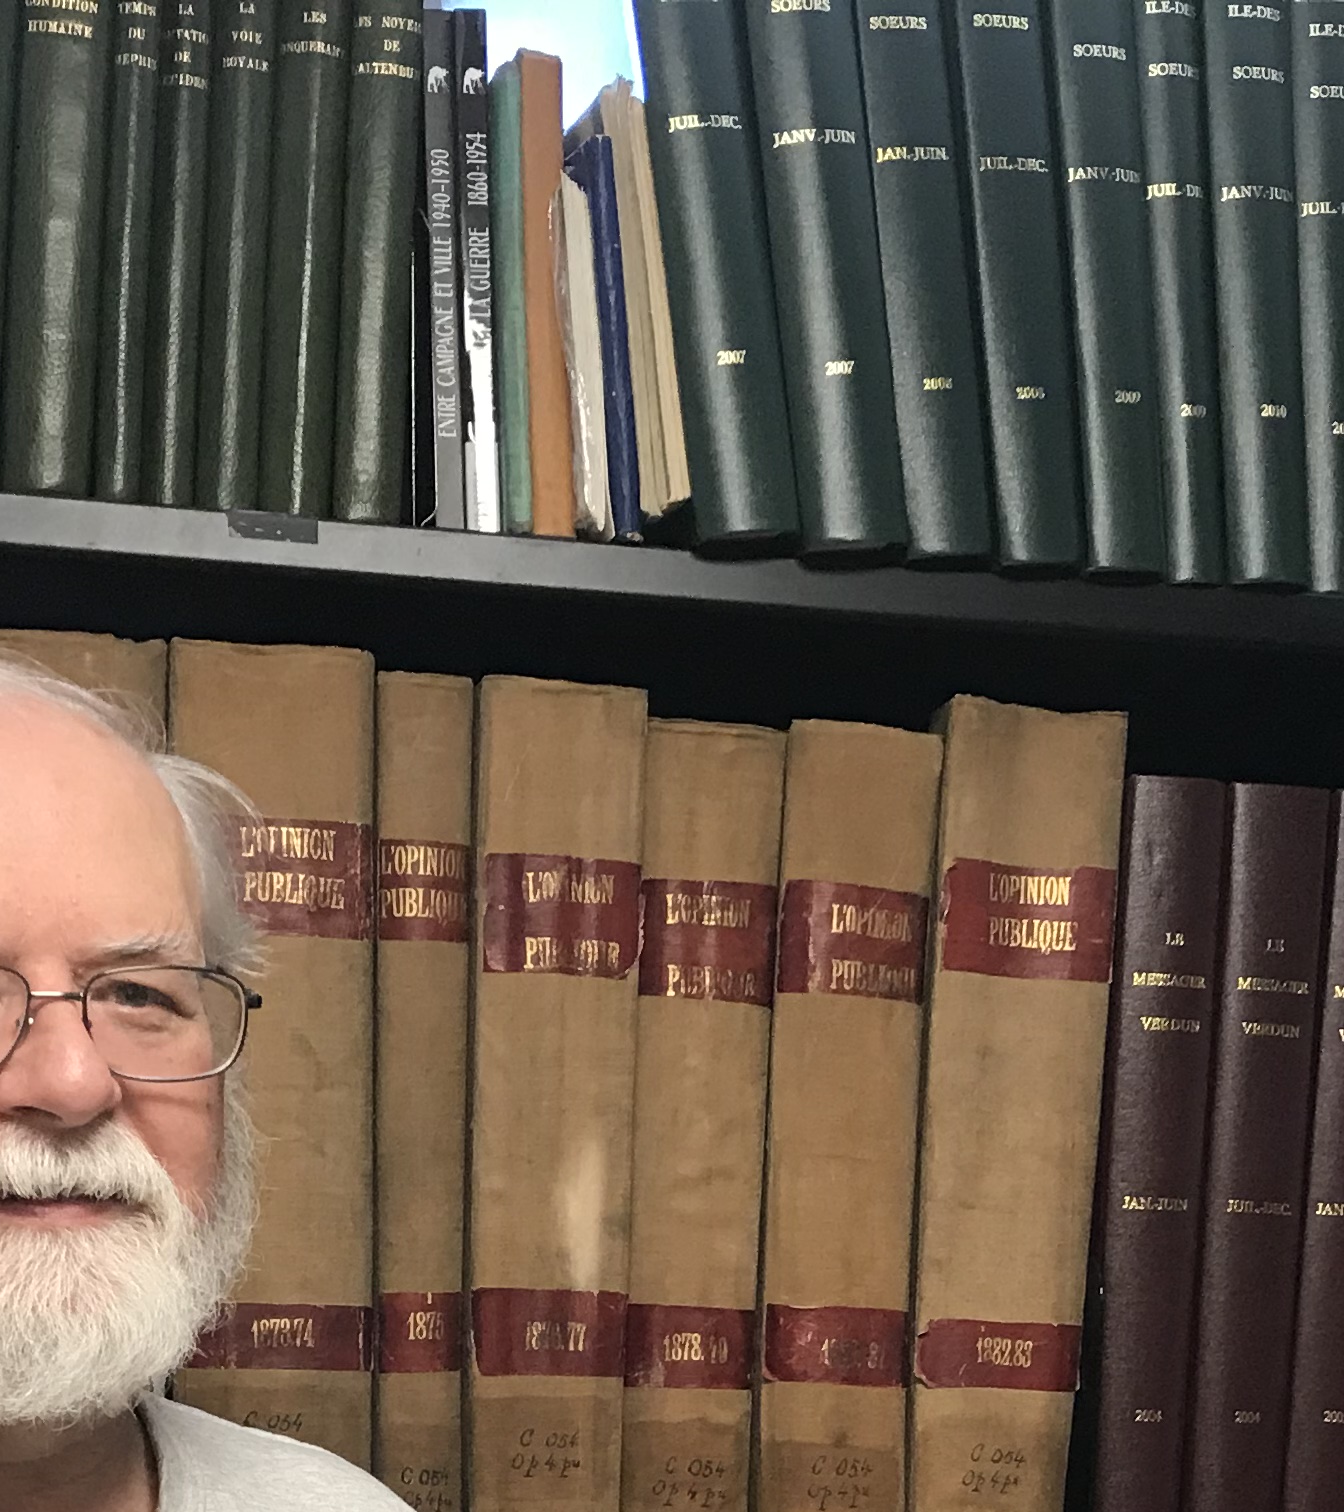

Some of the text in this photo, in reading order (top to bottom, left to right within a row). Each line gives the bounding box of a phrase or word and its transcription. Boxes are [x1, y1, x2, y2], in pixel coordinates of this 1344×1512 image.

[178, 3, 195, 16] LA
[239, 1, 255, 14] LA
[303, 11, 327, 24] LES
[869, 16, 928, 30] SOEURS
[972, 13, 1029, 30] SOEURS
[28, 19, 94, 39] HUMAINE
[128, 26, 146, 40] DU
[231, 30, 263, 45] VOIE
[383, 39, 401, 52] DE
[1073, 44, 1127, 61] SOEURS
[1232, 65, 1285, 83] SOEURS
[465, 131, 489, 206] 1860-1954
[467, 227, 492, 292] GUERRE
[430, 148, 457, 438] ENTRE CAMPAGNE ET VILLE 1940-1950
[716, 350, 747, 366] 2007
[824, 360, 855, 376] 2007
[1260, 403, 1288, 418] 2010
[243, 871, 346, 912] PUBLIQUE
[988, 872, 1073, 907] L'OPINION
[988, 917, 1079, 955] PUBLIQUE
[1165, 932, 1185, 946] LE
[1139, 1016, 1201, 1033] VERDUN
[1241, 1021, 1301, 1039] VERDUN
[974, 1336, 1034, 1368] 1882.83
[519, 1429, 580, 1449] C 054
[969, 1443, 1027, 1468] C 054
[664, 1456, 728, 1479] C 054
[811, 1456, 875, 1479] C 054
